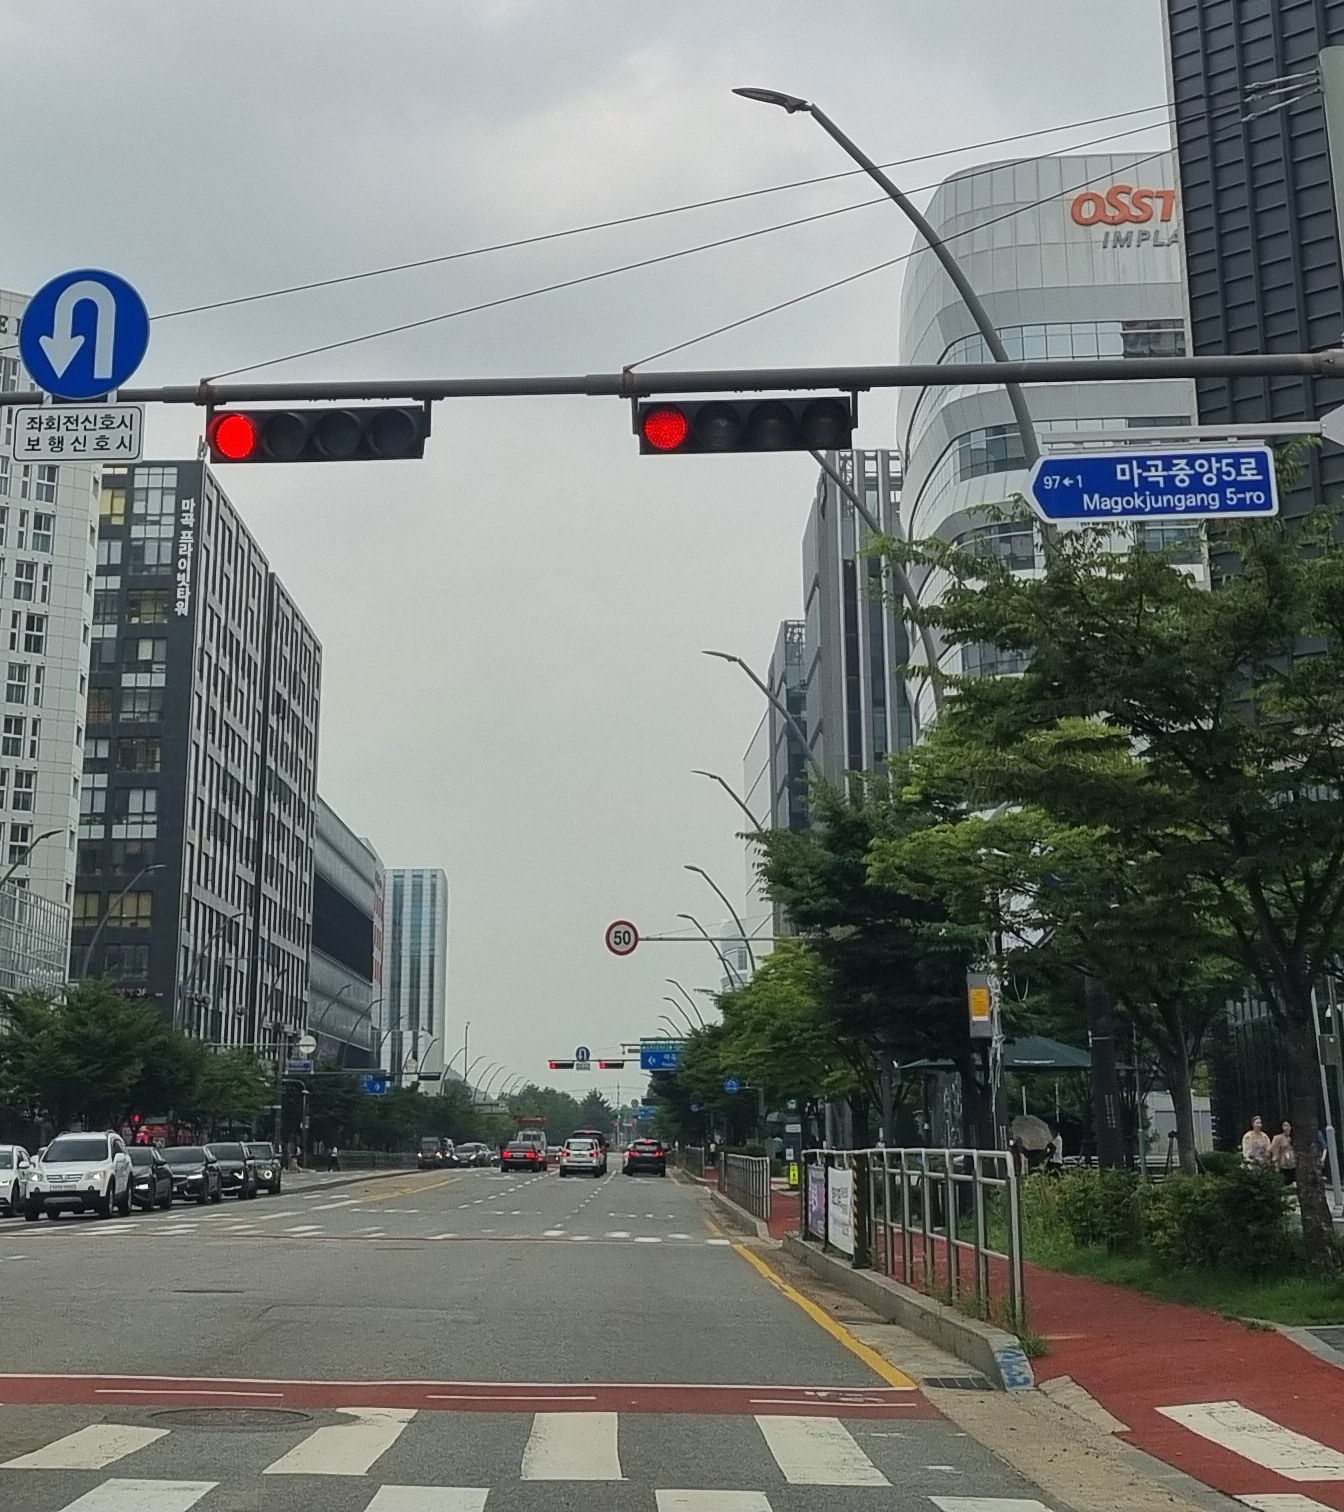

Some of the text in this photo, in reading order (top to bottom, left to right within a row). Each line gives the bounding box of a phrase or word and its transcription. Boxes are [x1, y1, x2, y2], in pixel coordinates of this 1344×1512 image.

[25, 413, 134, 433] 좌회전신호시
[1115, 457, 1264, 489] 마곡중앙5로
[180, 497, 196, 528] 마곡
[1082, 488, 1266, 514] Magokjungang 5-ro
[613, 930, 632, 946] 50
